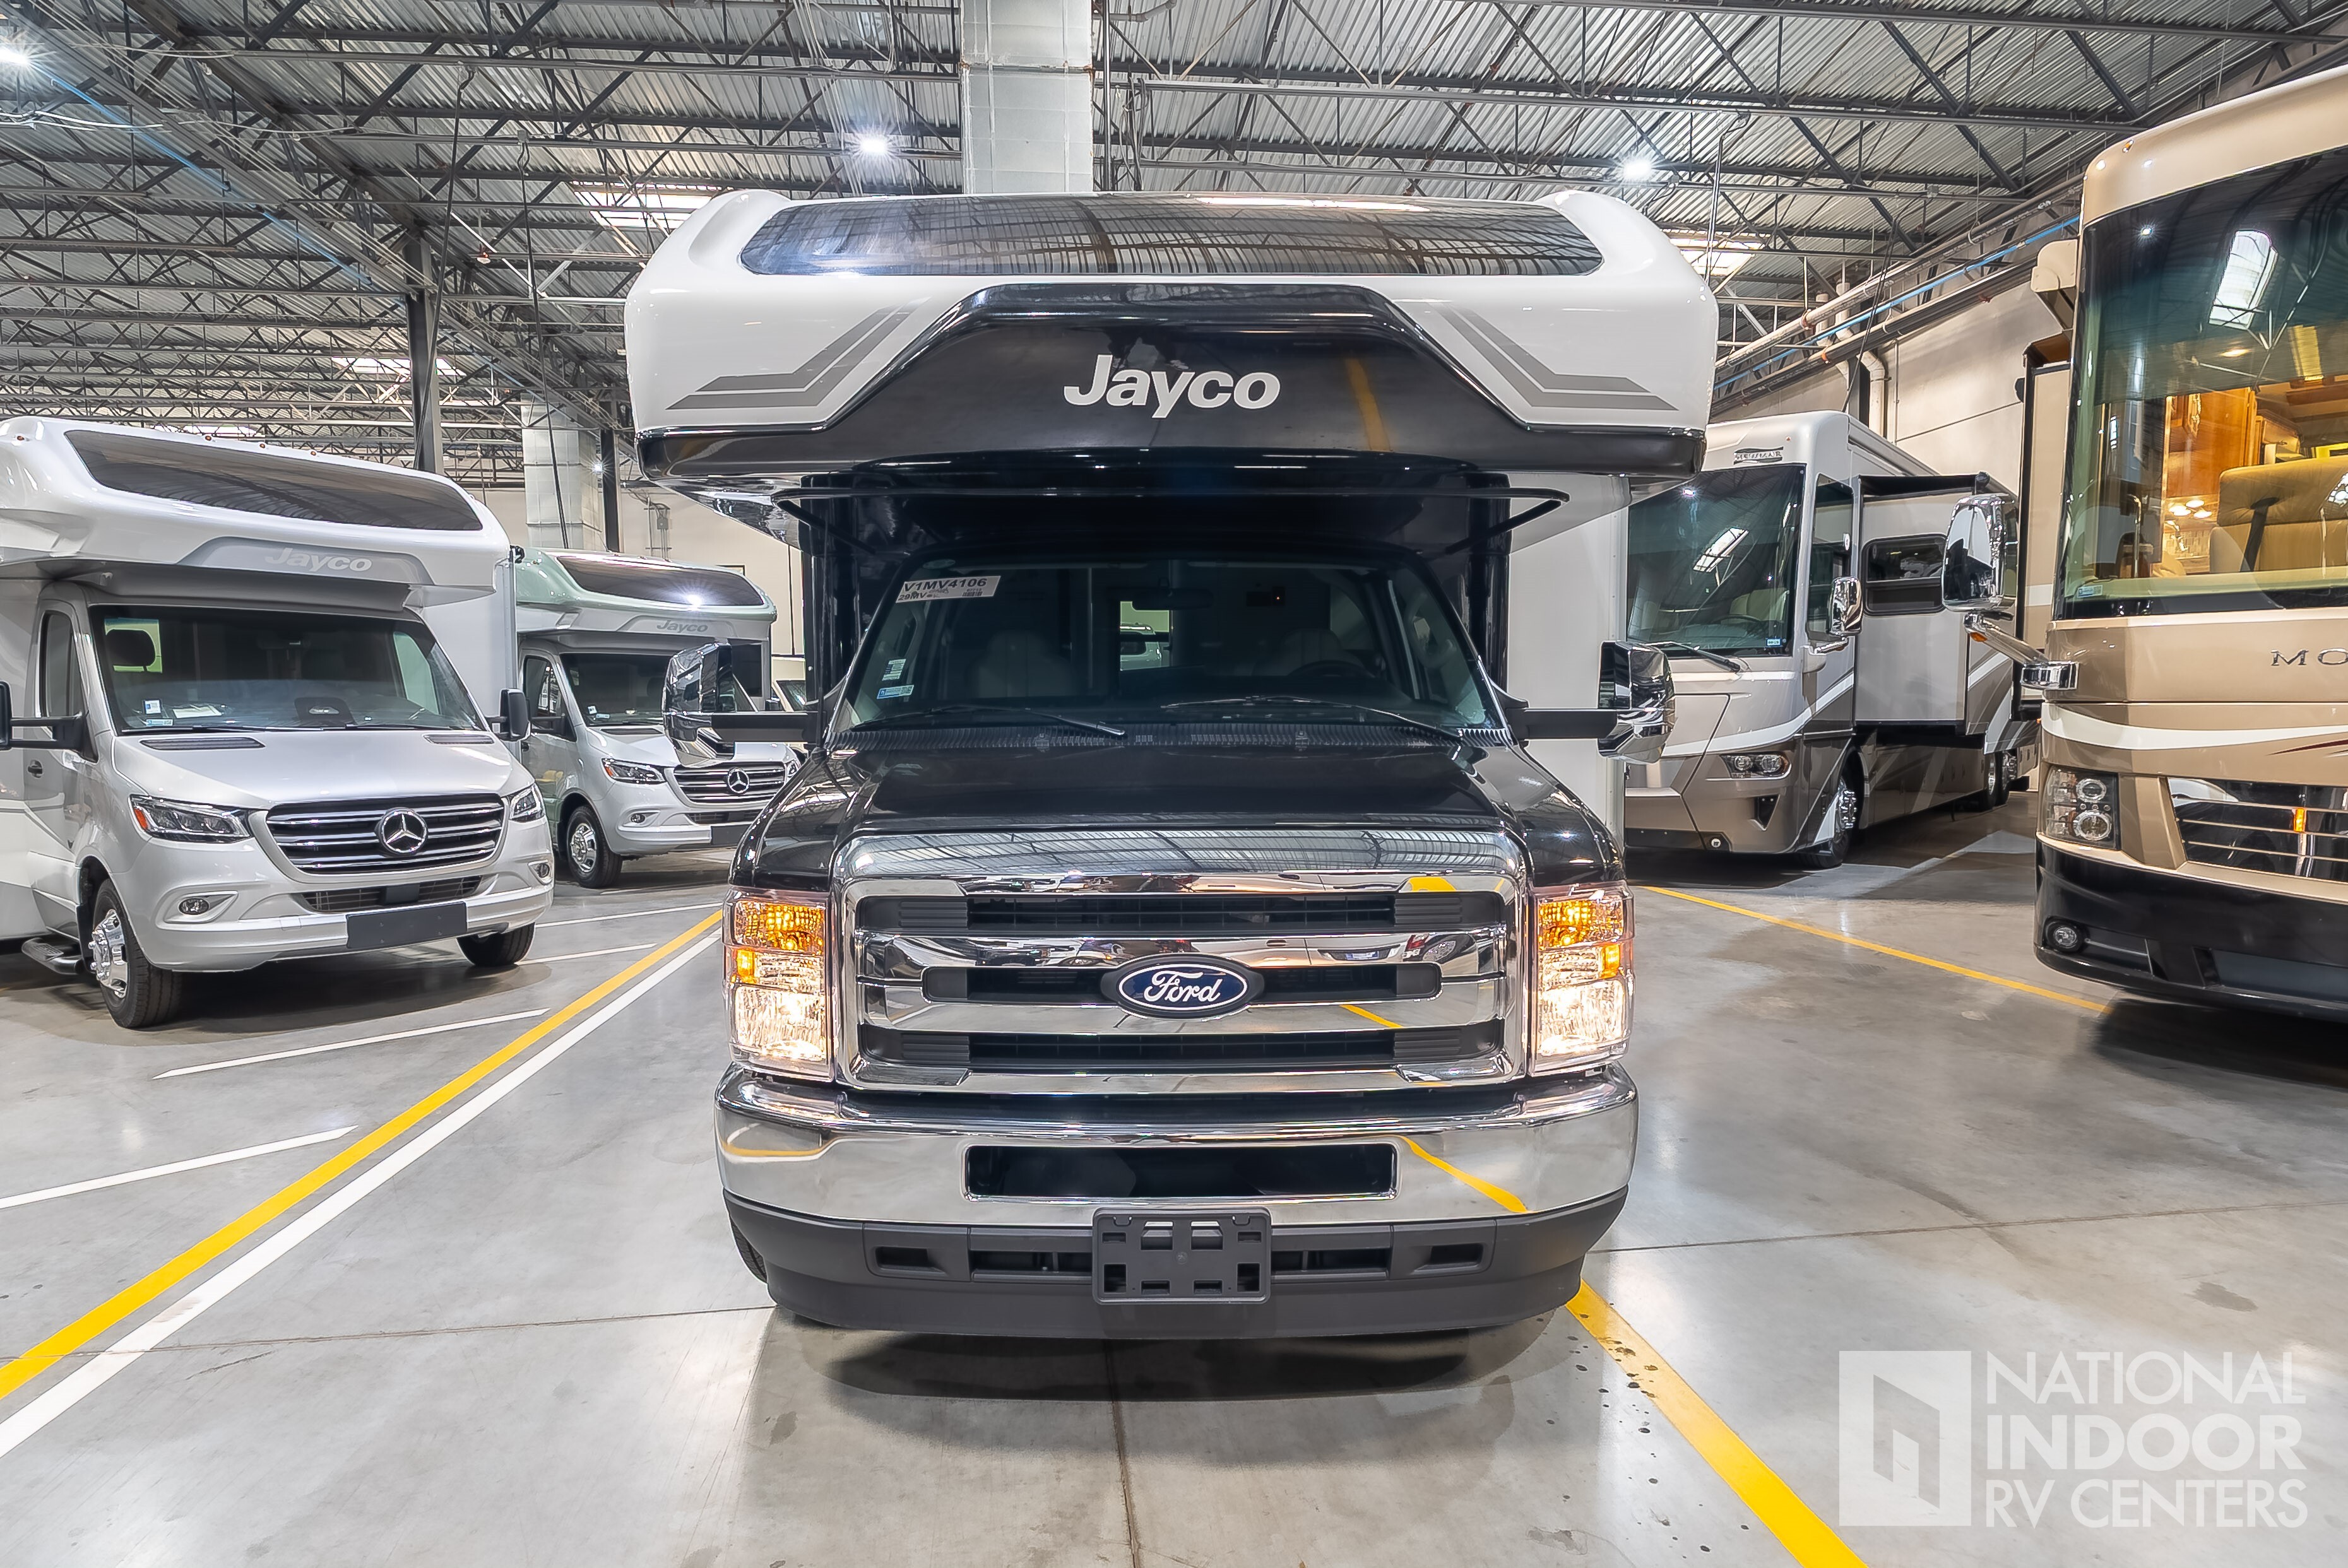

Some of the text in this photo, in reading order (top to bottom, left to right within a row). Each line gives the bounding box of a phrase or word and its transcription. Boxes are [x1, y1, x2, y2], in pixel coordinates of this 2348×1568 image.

[1064, 354, 1281, 418] Jayco
[264, 547, 372, 572] Jayco
[904, 578, 987, 592] V1MV4106
[656, 620, 708, 633] Jayco
[1143, 970, 1223, 1002] Ford
